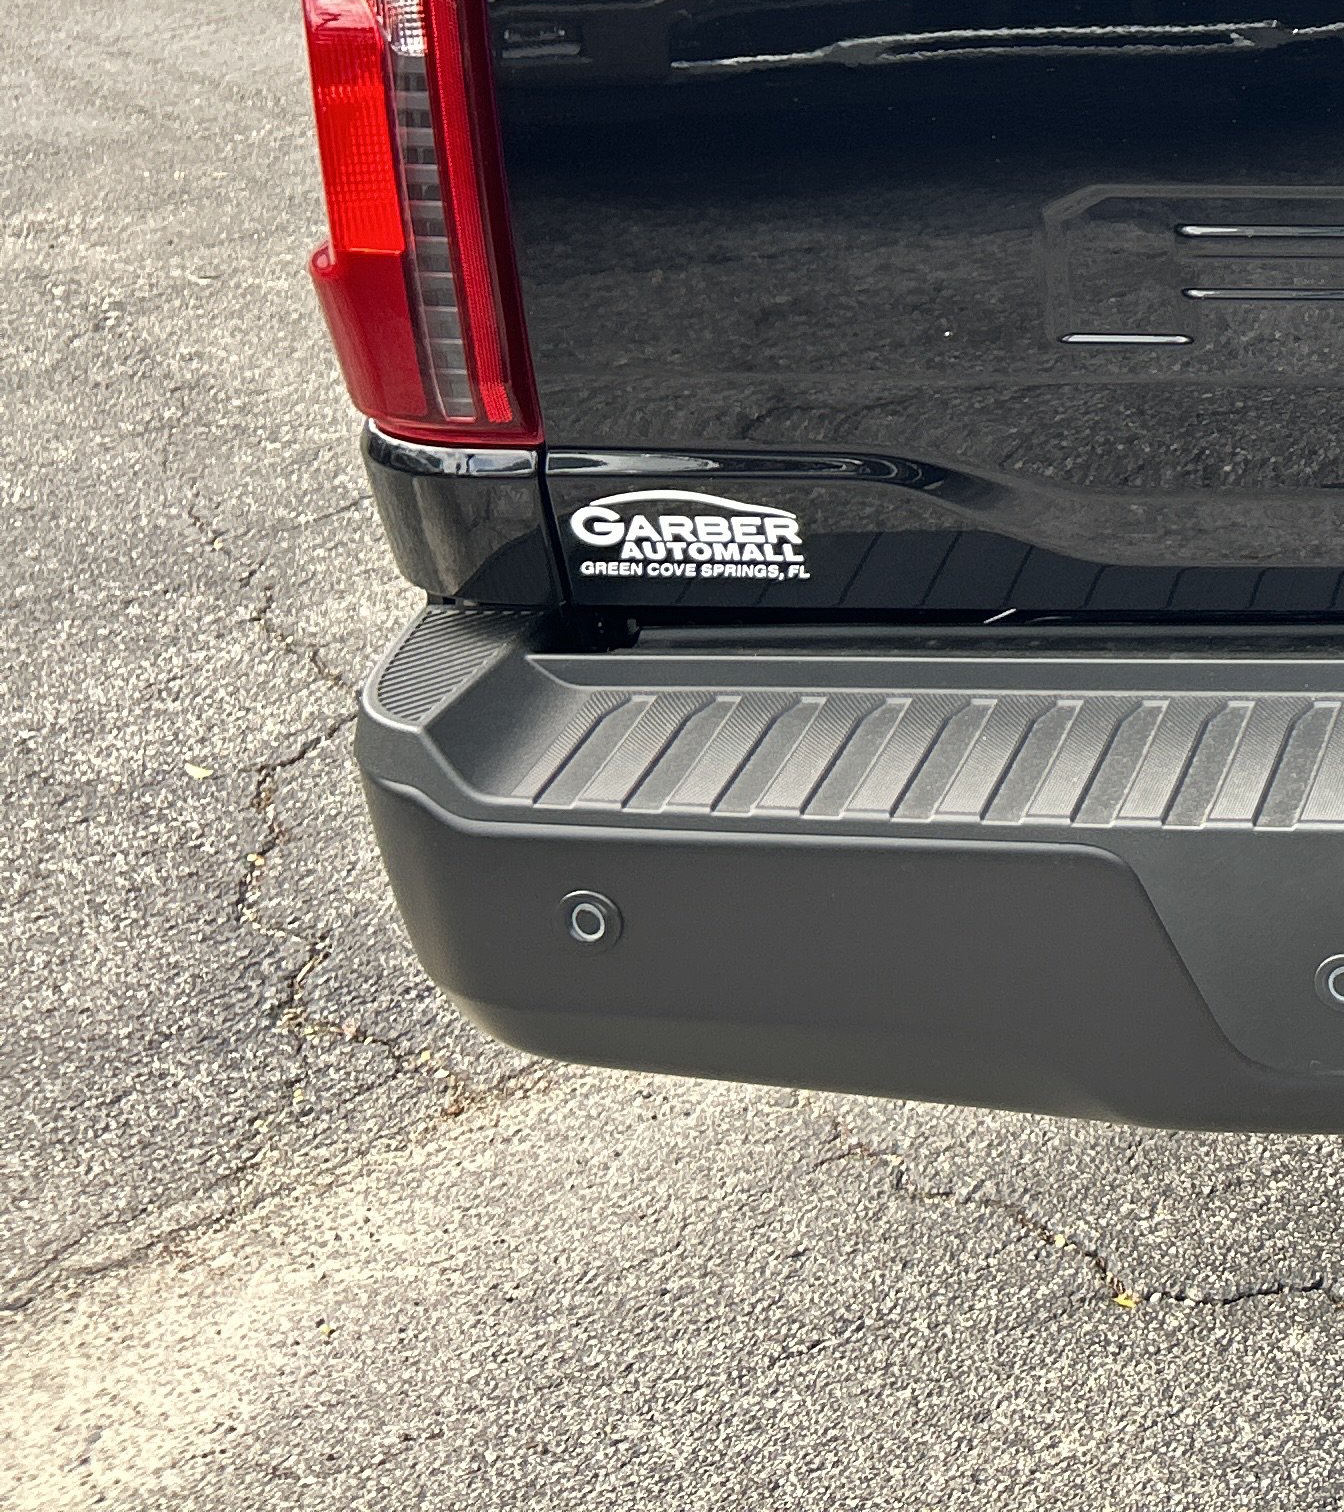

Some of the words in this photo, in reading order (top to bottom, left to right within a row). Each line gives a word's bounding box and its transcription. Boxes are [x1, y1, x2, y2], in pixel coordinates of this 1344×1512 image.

[570, 506, 803, 546] GARBER
[620, 541, 805, 563] AUTOMALL
[580, 561, 643, 577] GREEN
[646, 562, 697, 578] COVE
[700, 563, 785, 581] SPRINGS,
[787, 565, 811, 579] FL
